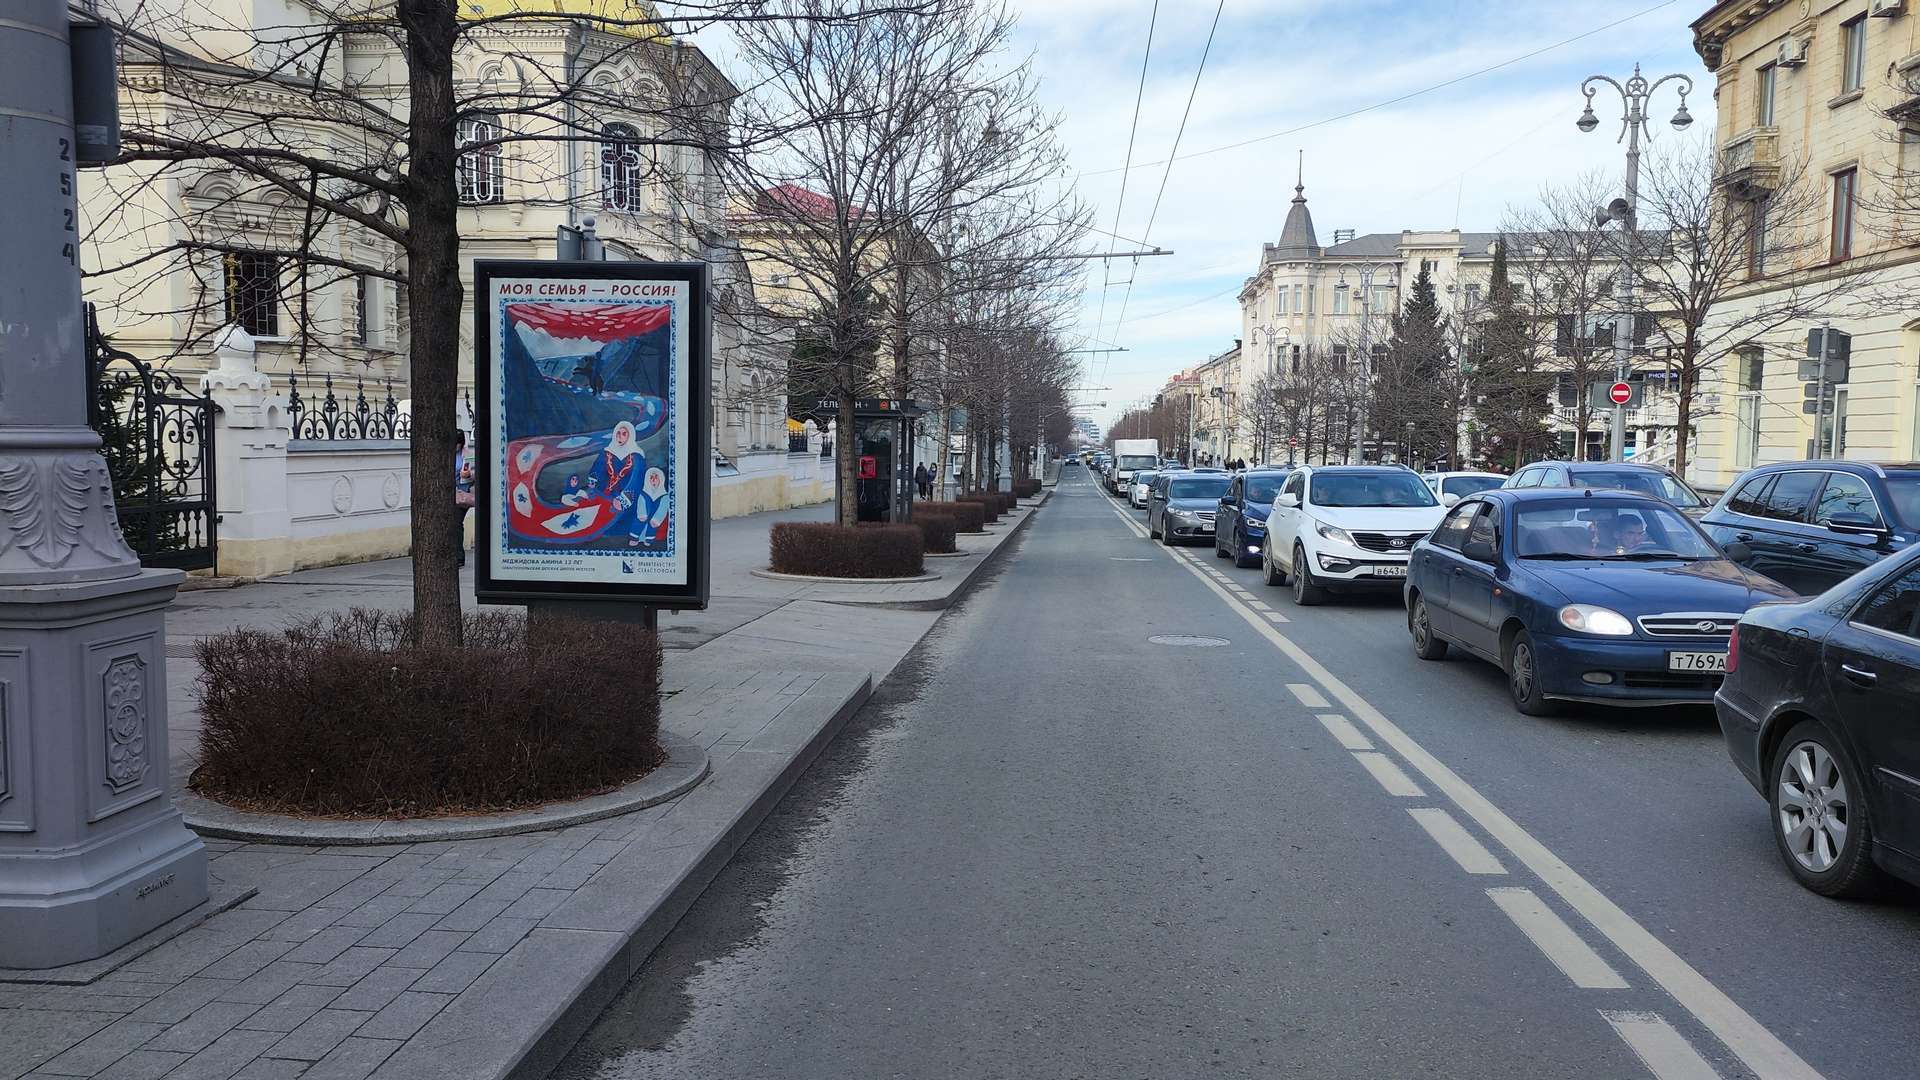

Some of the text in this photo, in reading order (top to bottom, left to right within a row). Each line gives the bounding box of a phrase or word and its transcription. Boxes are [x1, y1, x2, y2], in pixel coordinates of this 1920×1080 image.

[499, 283, 533, 295] МОЯ
[538, 284, 586, 296] СЕМЬЯ
[611, 284, 676, 297] РОССИЯ!
